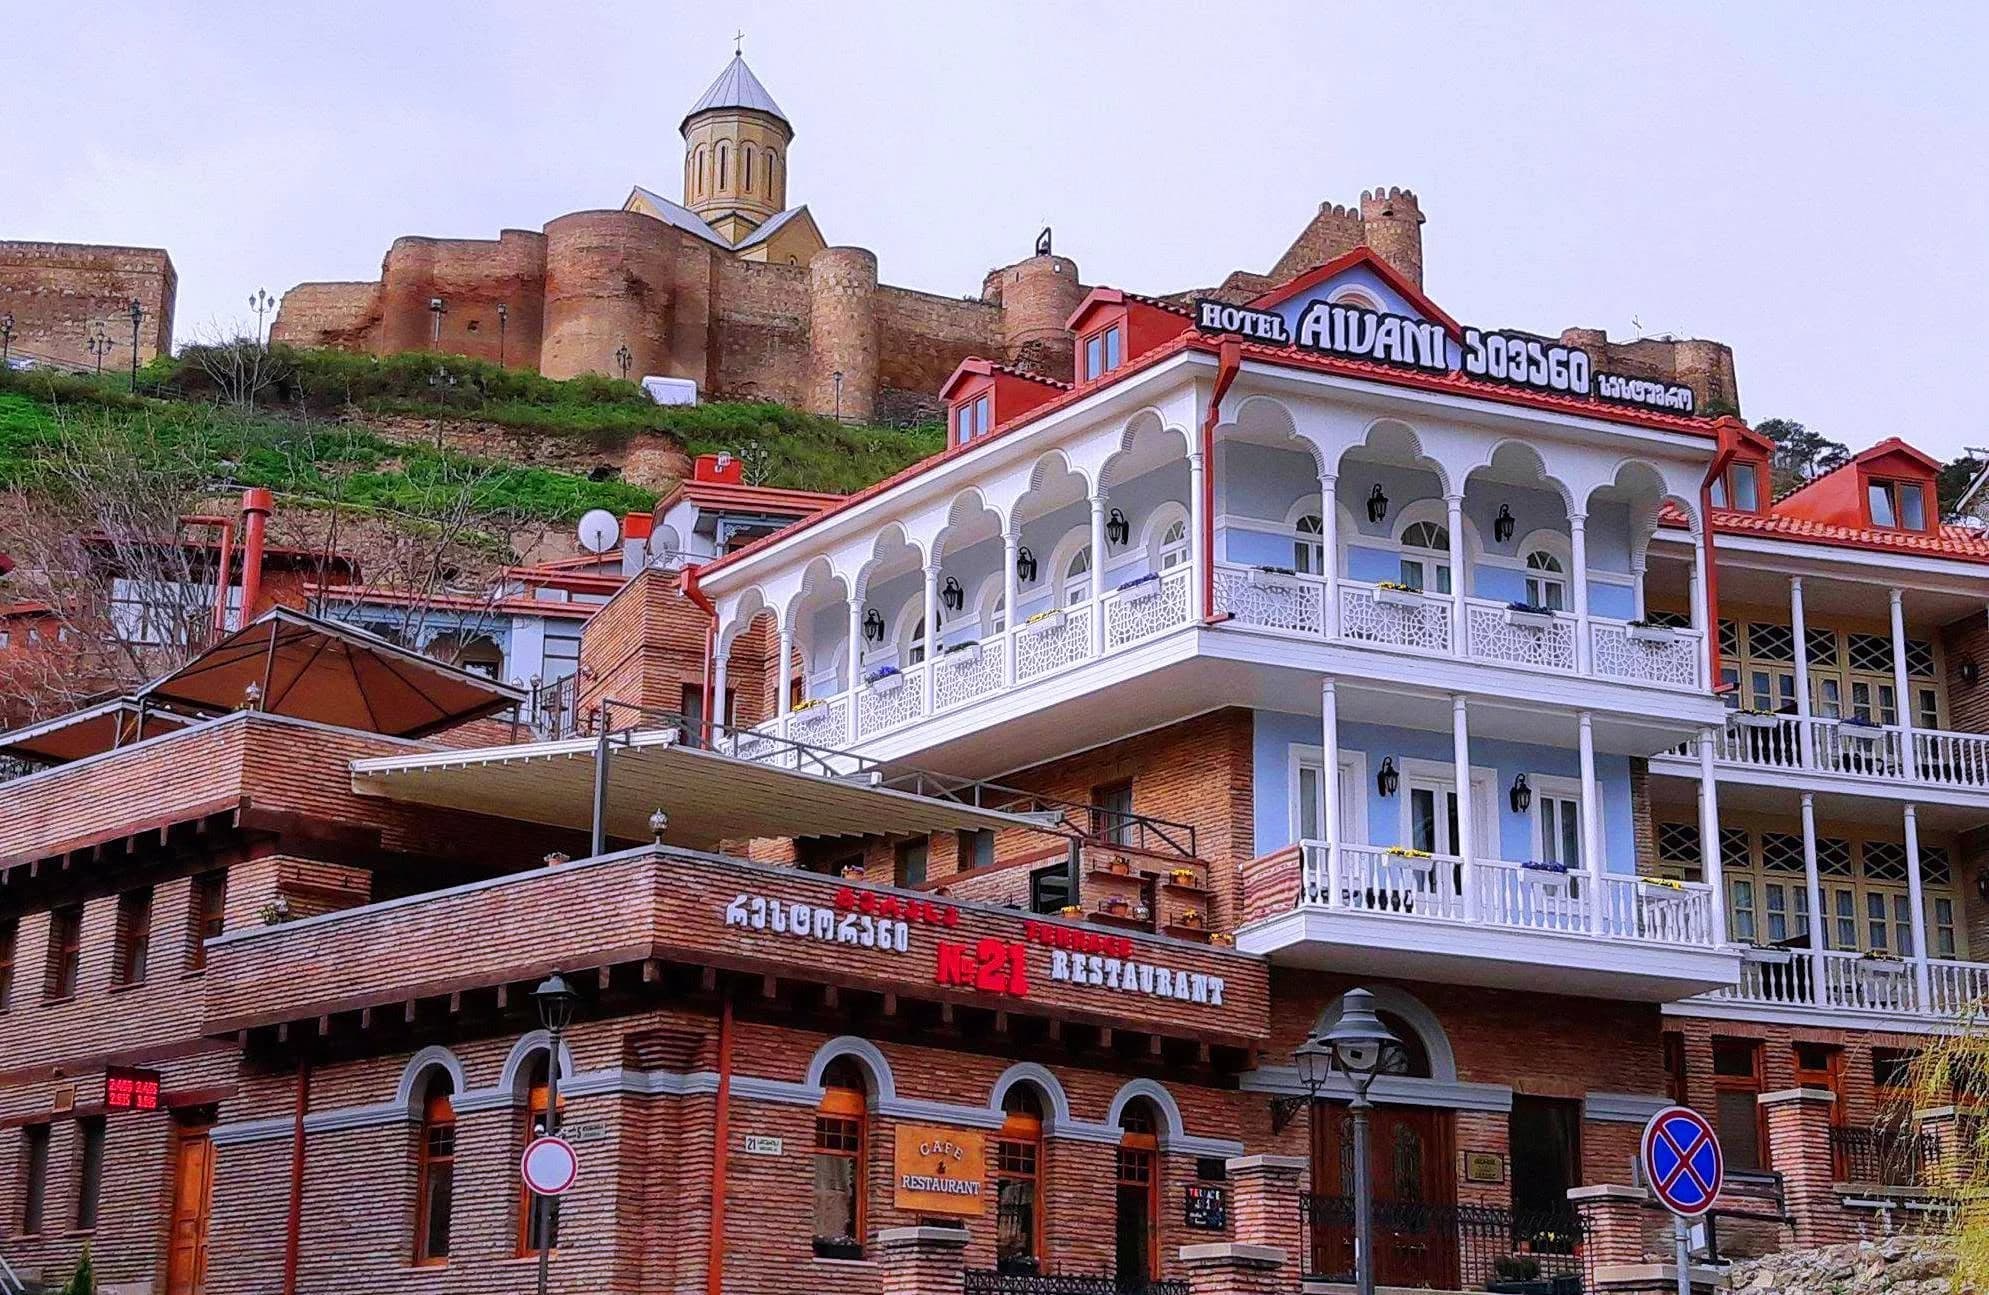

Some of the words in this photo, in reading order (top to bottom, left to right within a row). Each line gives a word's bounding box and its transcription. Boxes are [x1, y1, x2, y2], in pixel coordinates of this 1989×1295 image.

[1201, 303, 1287, 342] HOTEL
[1465, 329, 1590, 394] აივანი
[726, 893, 909, 952] რესტორანი
[1051, 949, 1225, 1006] RESTAURANT
[747, 1137, 756, 1150] 21
[919, 1140, 964, 1161] CAFE
[902, 1174, 981, 1195] RESTAURANT
